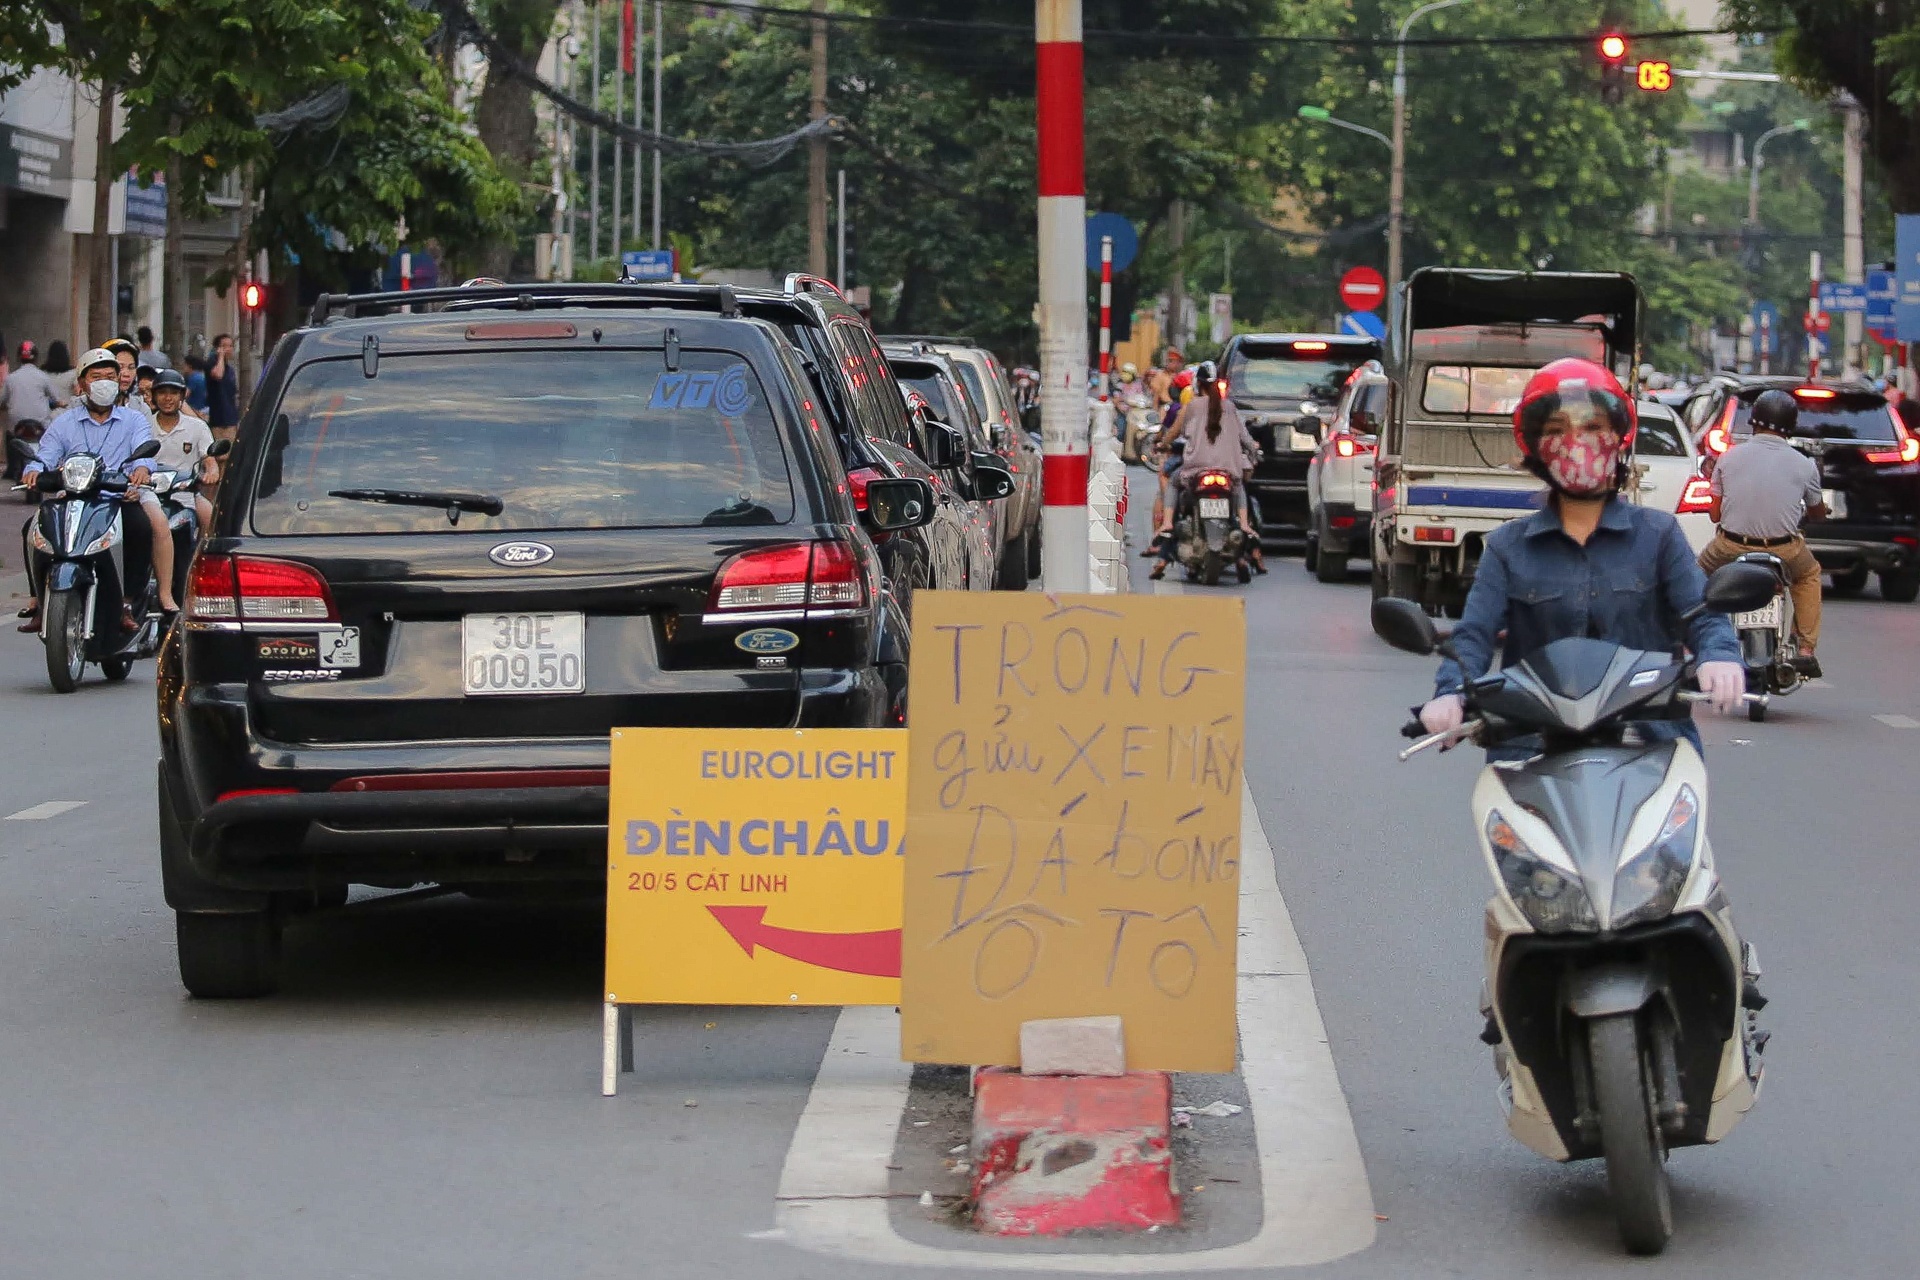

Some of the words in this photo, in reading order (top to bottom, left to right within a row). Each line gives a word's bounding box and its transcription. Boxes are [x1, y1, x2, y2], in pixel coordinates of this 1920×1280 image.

[1638, 61, 1671, 90] 06
[504, 546, 539, 561] Ford
[493, 615, 555, 649] 30E
[933, 604, 1228, 705] TRÔNG
[263, 669, 342, 680] ESCAPE
[468, 653, 580, 689] 009.50
[701, 749, 897, 780] EUROLIGHT
[1052, 722, 1152, 787] XE
[1166, 714, 1241, 796] MÁY
[628, 872, 678, 893] 20/5
[740, 874, 788, 893] LINH
